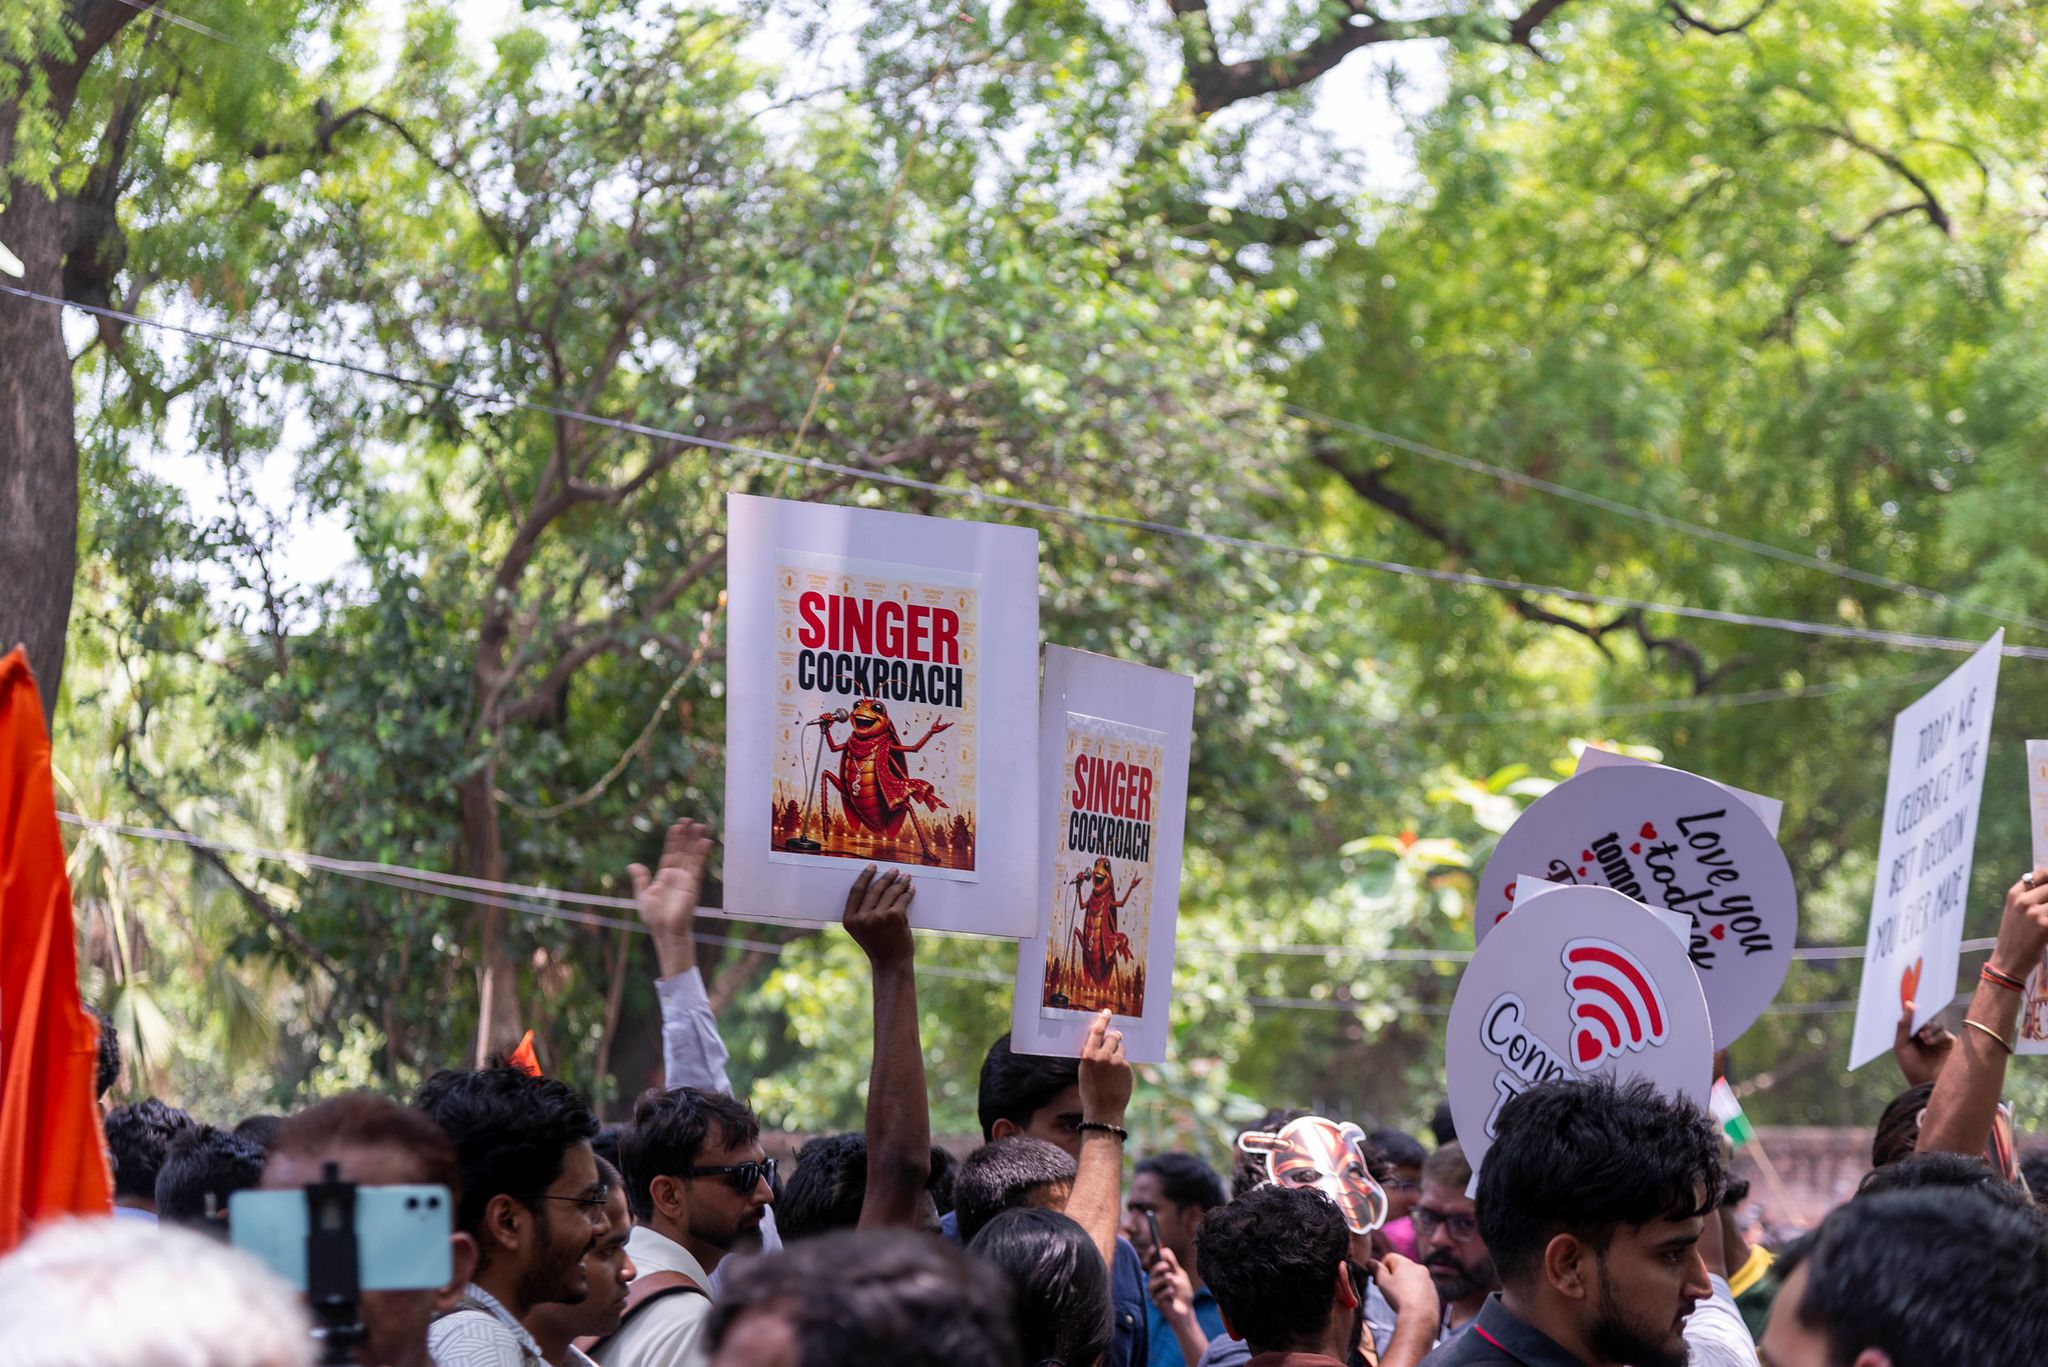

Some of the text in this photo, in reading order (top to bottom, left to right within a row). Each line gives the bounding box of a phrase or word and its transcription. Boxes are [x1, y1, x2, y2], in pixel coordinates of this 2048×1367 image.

[799, 591, 959, 665] SINGER
[799, 649, 963, 707] COCKROACH
[1916, 686, 1977, 769] TODAY WE
[1072, 753, 1153, 822] SINGER
[1896, 740, 1979, 835] CELEBRATE THE
[1068, 811, 1151, 863] COCKROACH
[1591, 832, 1648, 904] tomo
[1889, 804, 1967, 898] BEST DECISION
[1676, 809, 1773, 957] Love you
[1872, 864, 1964, 964] YOU EVER MADE
[1488, 1002, 1564, 1081] Conn
